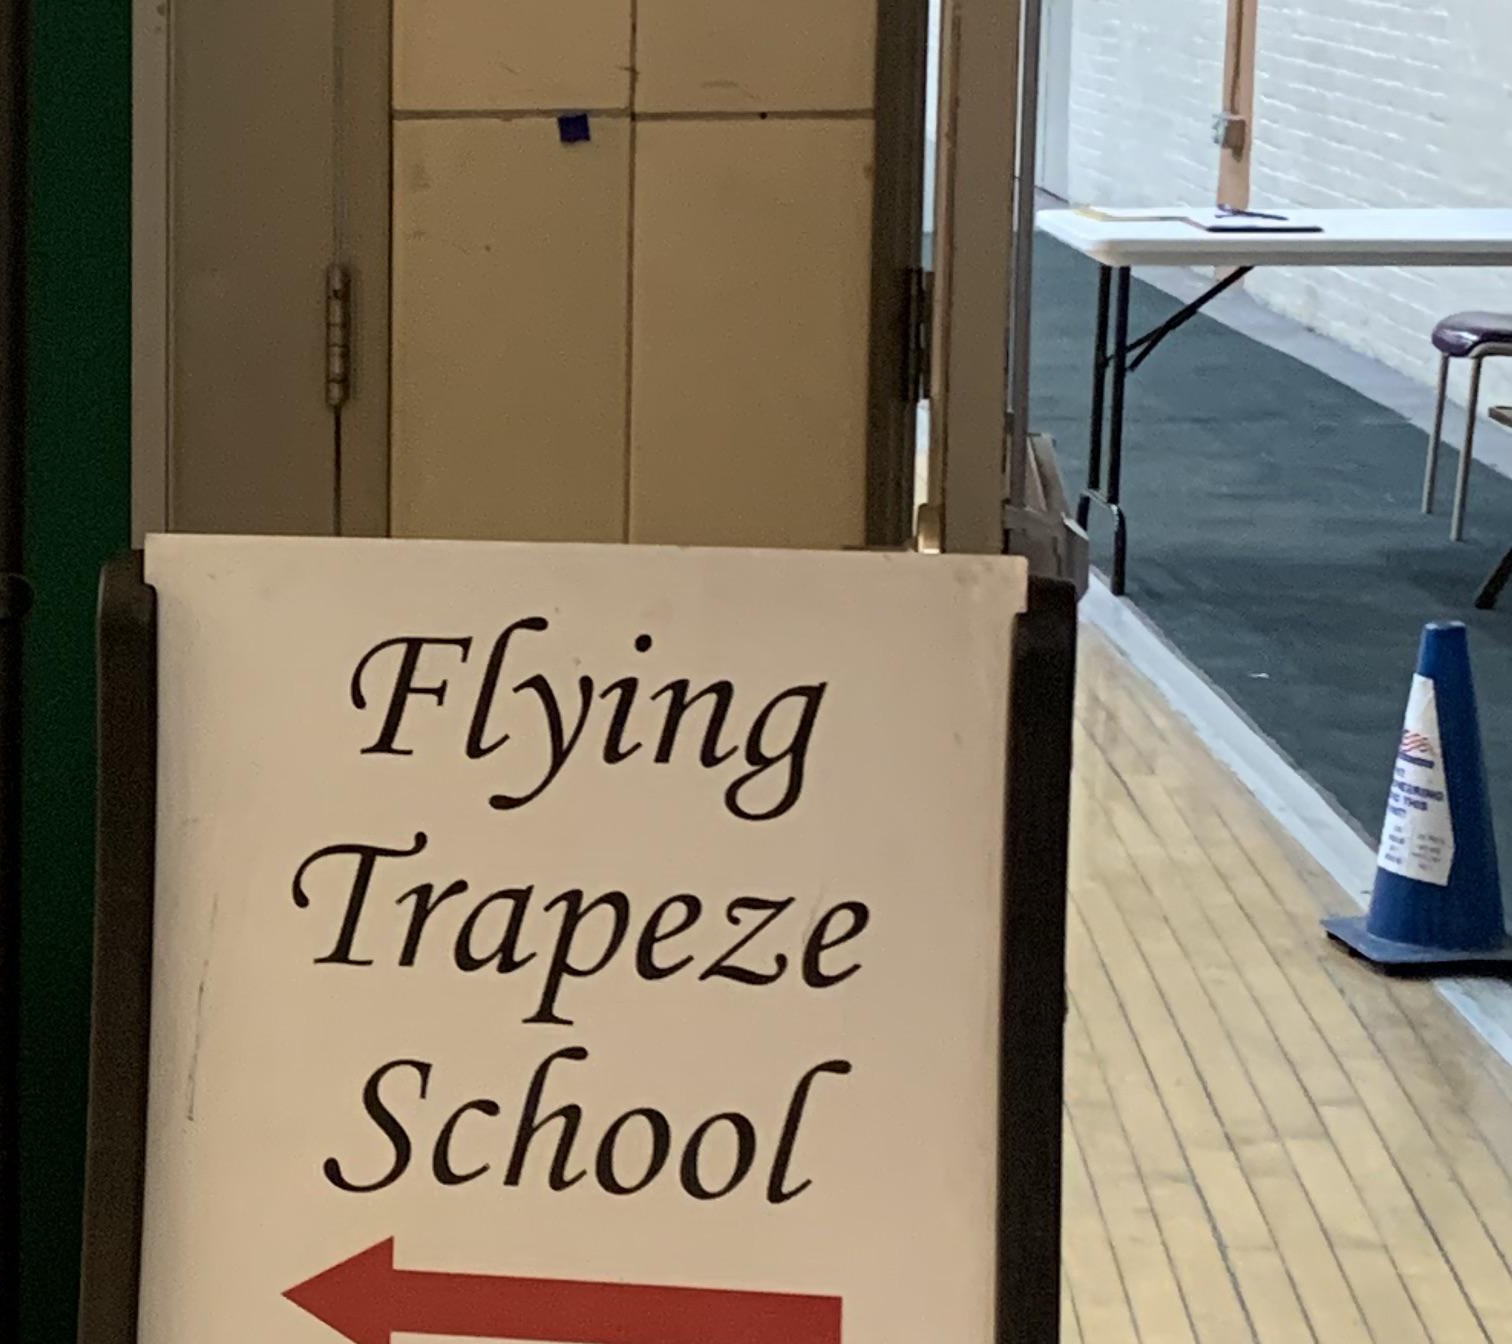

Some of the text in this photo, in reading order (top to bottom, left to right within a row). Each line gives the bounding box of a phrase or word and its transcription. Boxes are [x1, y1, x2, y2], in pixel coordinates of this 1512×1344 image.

[350, 616, 829, 822] Flying
[291, 830, 872, 1026] Trapeze
[323, 1046, 853, 1206] School
